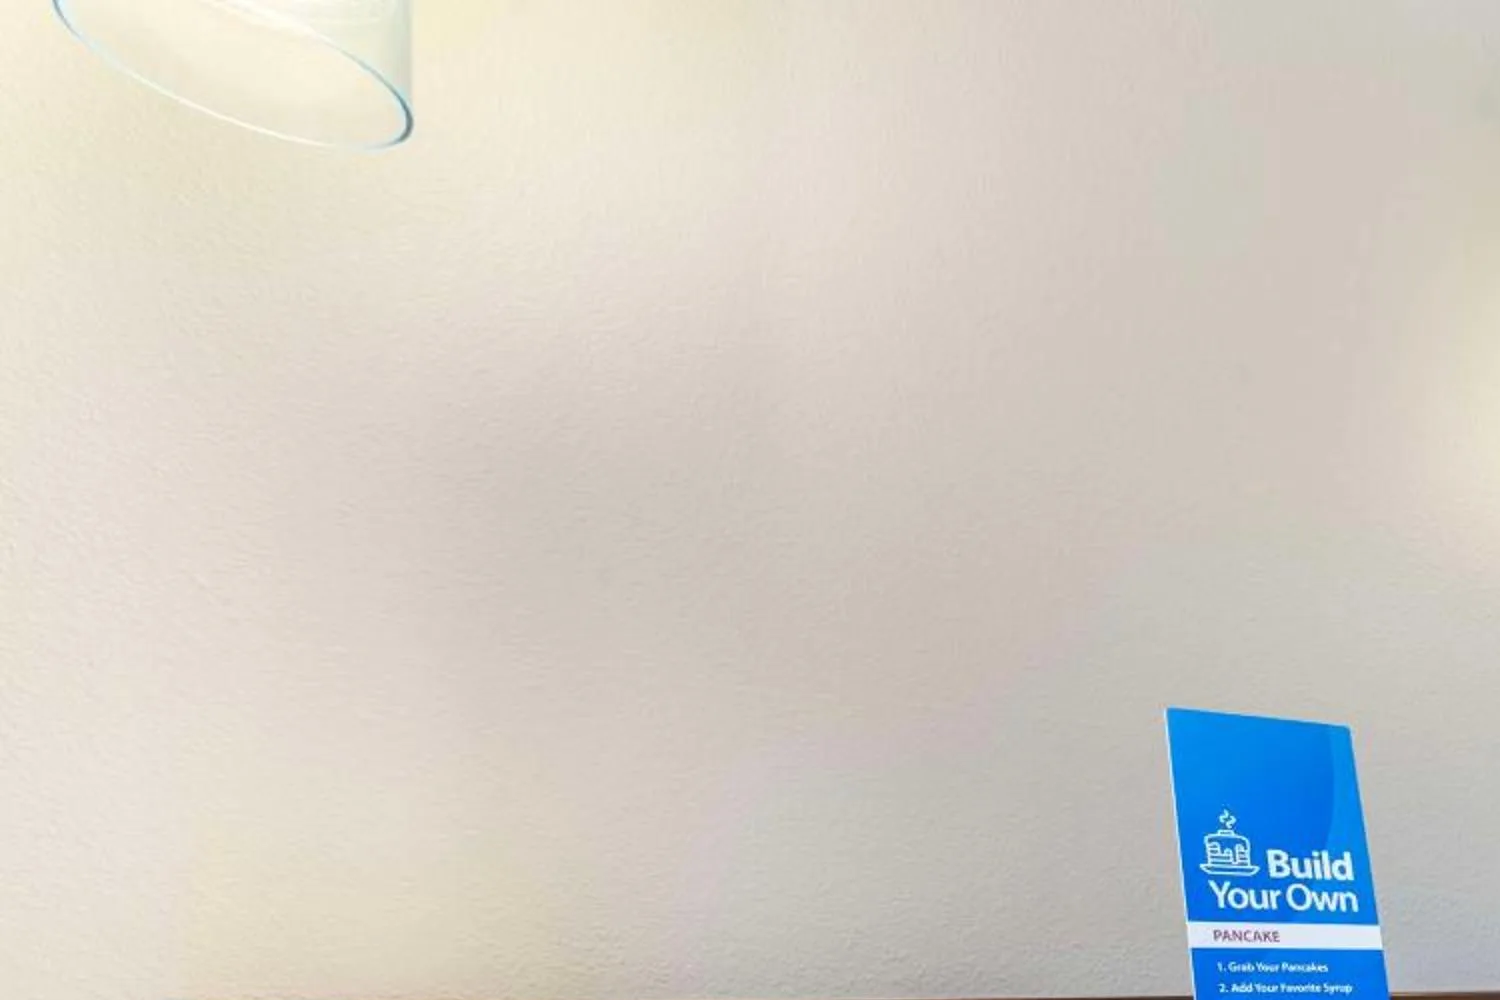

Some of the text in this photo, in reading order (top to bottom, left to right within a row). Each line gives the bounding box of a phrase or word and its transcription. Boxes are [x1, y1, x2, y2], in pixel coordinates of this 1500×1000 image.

[1266, 849, 1355, 881] Build
[1208, 880, 1359, 912] Your Own
[1213, 929, 1281, 943] PANCAKE
[1217, 961, 1329, 973] 1. Grab Your Pancakes
[1219, 983, 1353, 996] 2. Add Your Favorite Syrup
